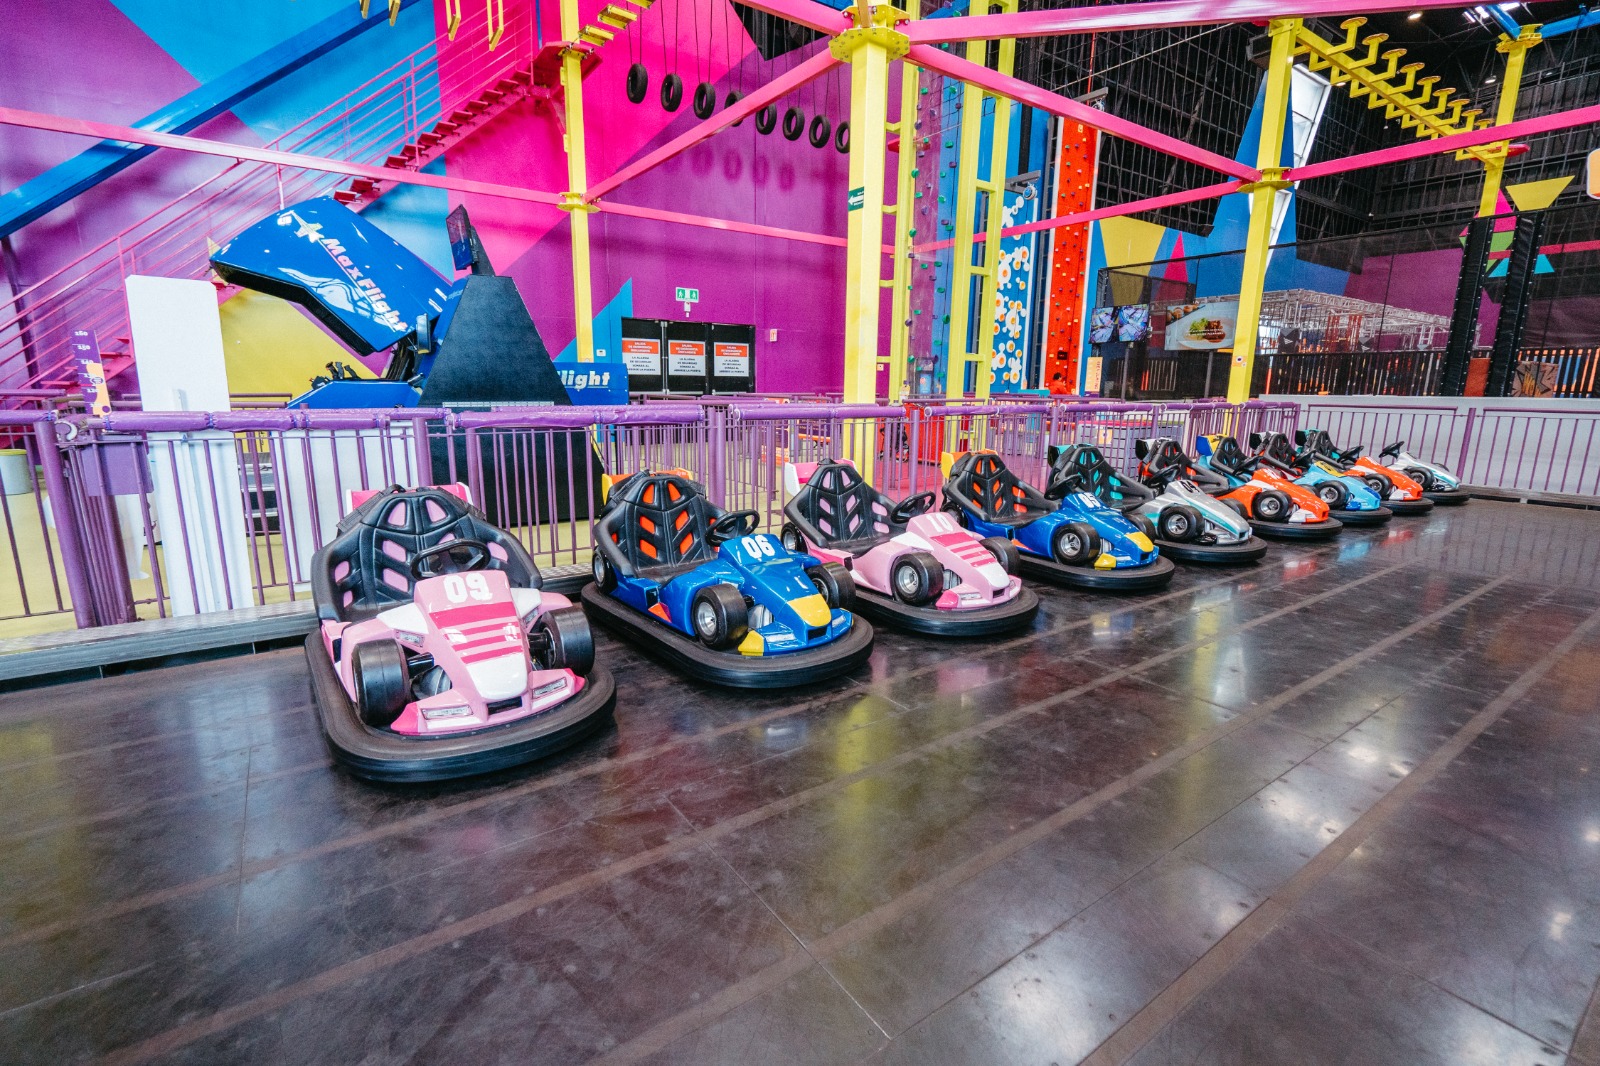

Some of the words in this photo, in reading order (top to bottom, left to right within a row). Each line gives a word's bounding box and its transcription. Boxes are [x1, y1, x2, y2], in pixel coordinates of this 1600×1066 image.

[557, 370, 610, 390] light
[1077, 492, 1102, 508] 05
[926, 512, 954, 533] 10
[741, 534, 776, 559] 06
[442, 572, 493, 604] 09
